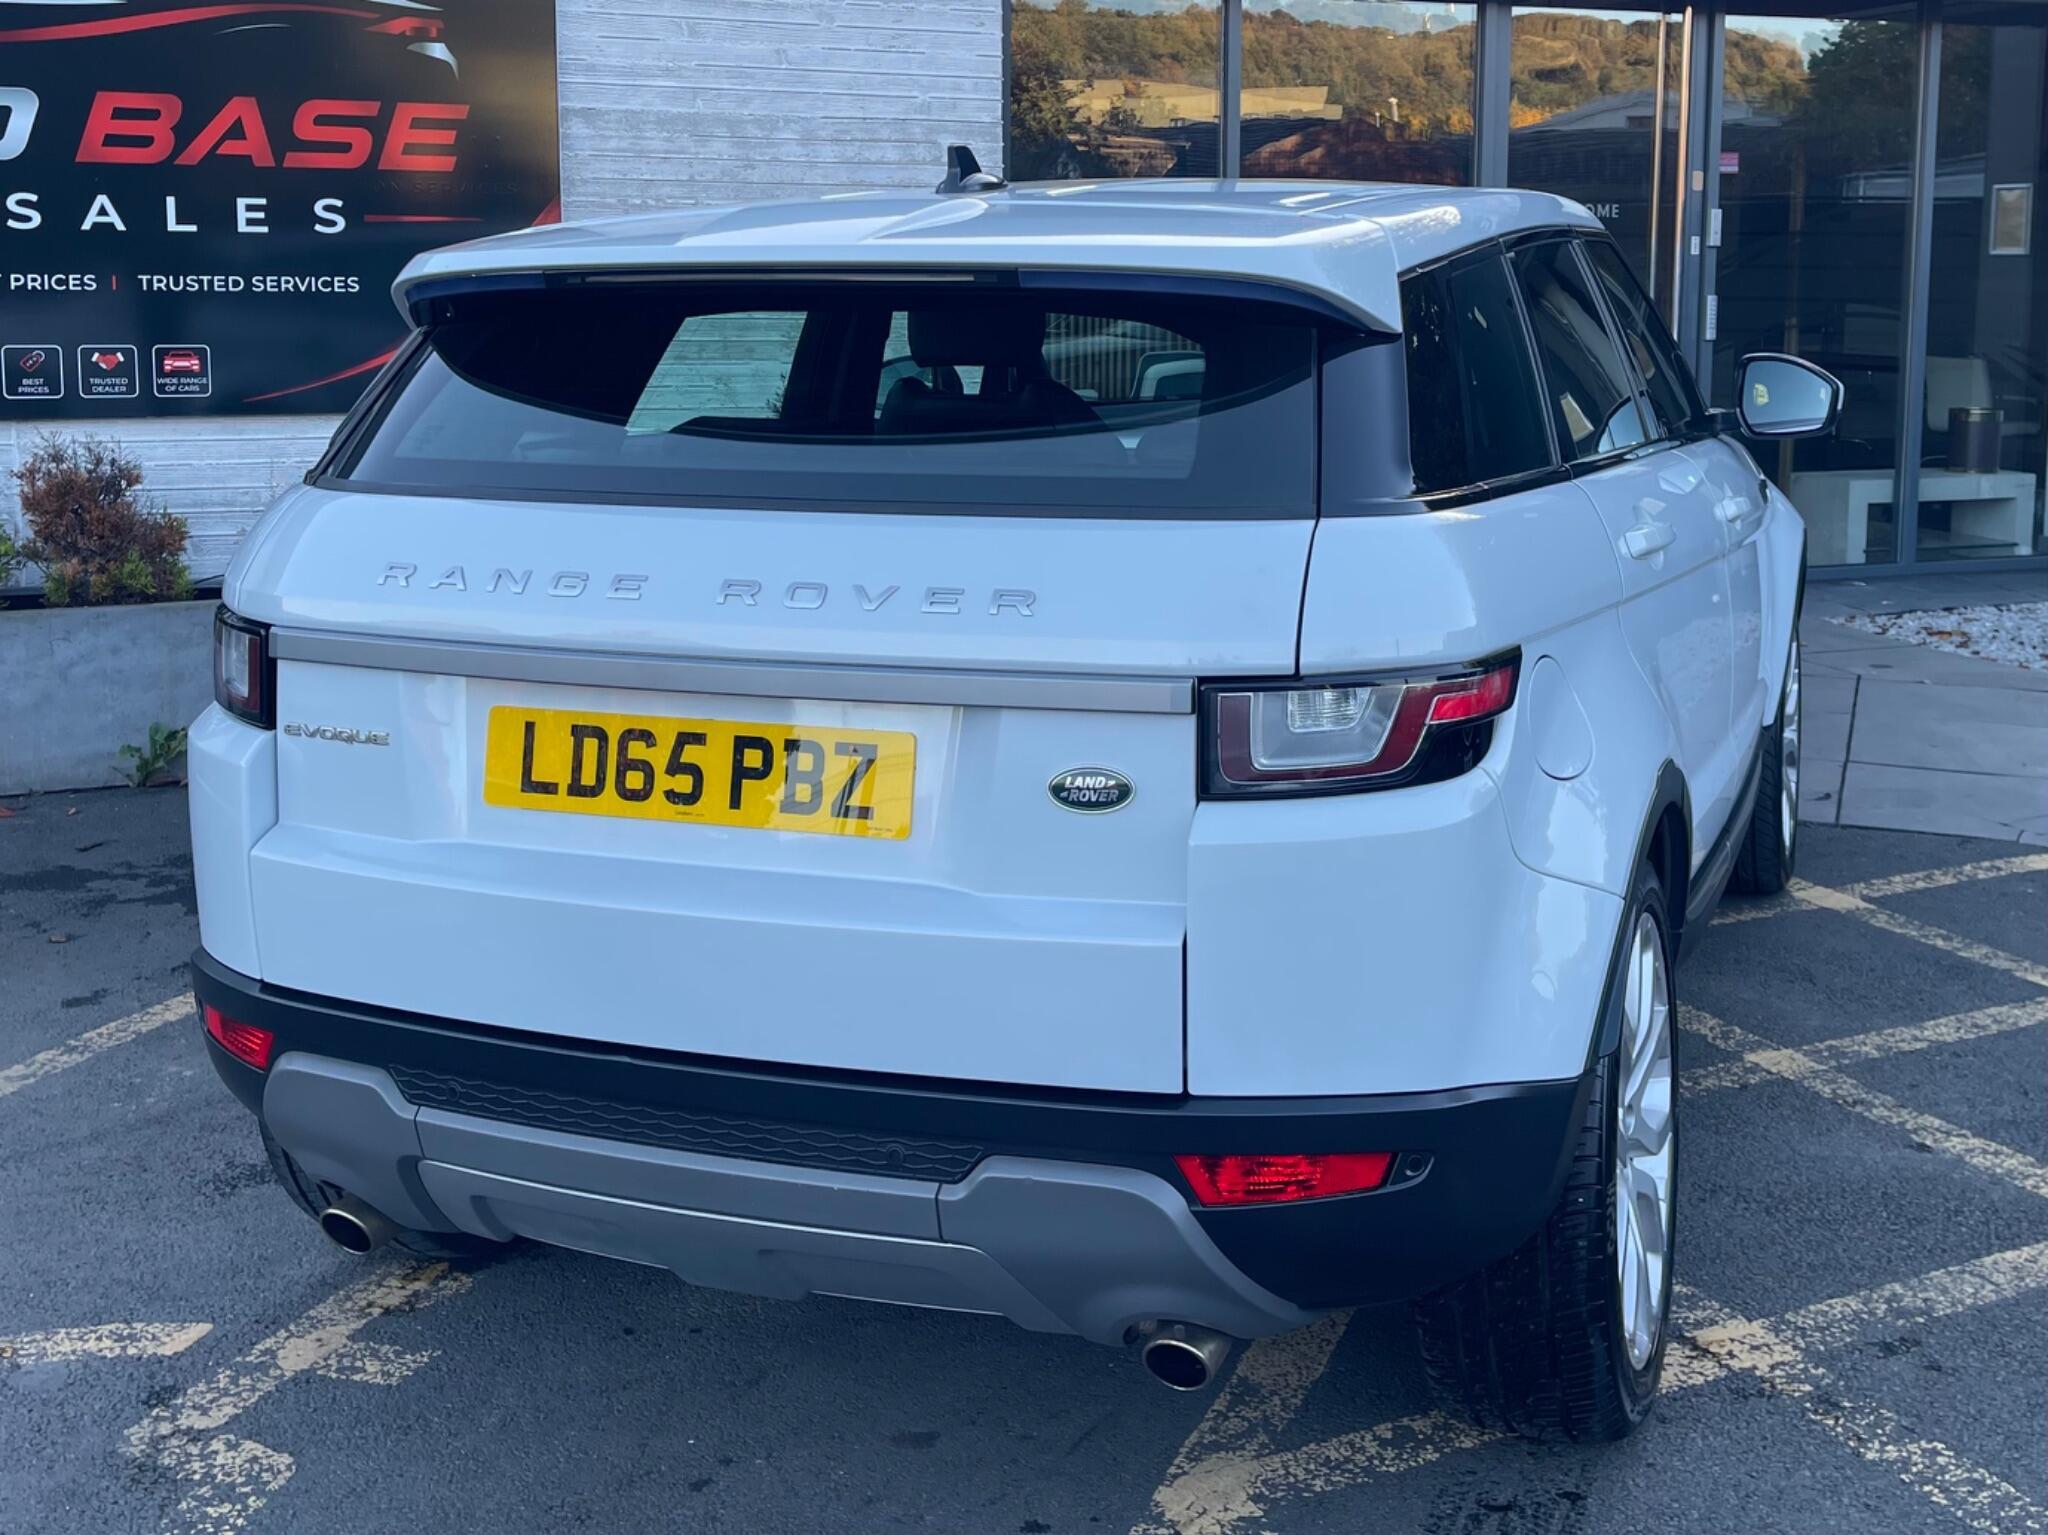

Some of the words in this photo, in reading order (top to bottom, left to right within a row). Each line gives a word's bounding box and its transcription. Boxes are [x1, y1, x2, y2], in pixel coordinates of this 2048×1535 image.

[75, 90, 471, 173] BASE
[5, 191, 347, 234] SALES
[9, 273, 98, 291] PRICES
[137, 274, 245, 292] TRUSTED
[251, 274, 360, 293] SERVICES
[21, 377, 44, 386] BEST
[89, 377, 129, 386] TRUSTED
[156, 377, 178, 385] WIDE
[179, 377, 208, 386] RANGE
[164, 384, 177, 392] OF
[178, 384, 200, 392] CARS
[18, 386, 50, 394] PRICES
[91, 385, 128, 393] DEALER
[376, 561, 649, 600] RANGE
[716, 578, 1038, 617] ROVER
[283, 722, 391, 746] EVOQUE
[520, 720, 707, 807] LD65
[1064, 776, 1106, 789] LAND
[1067, 789, 1119, 802] ROVER
